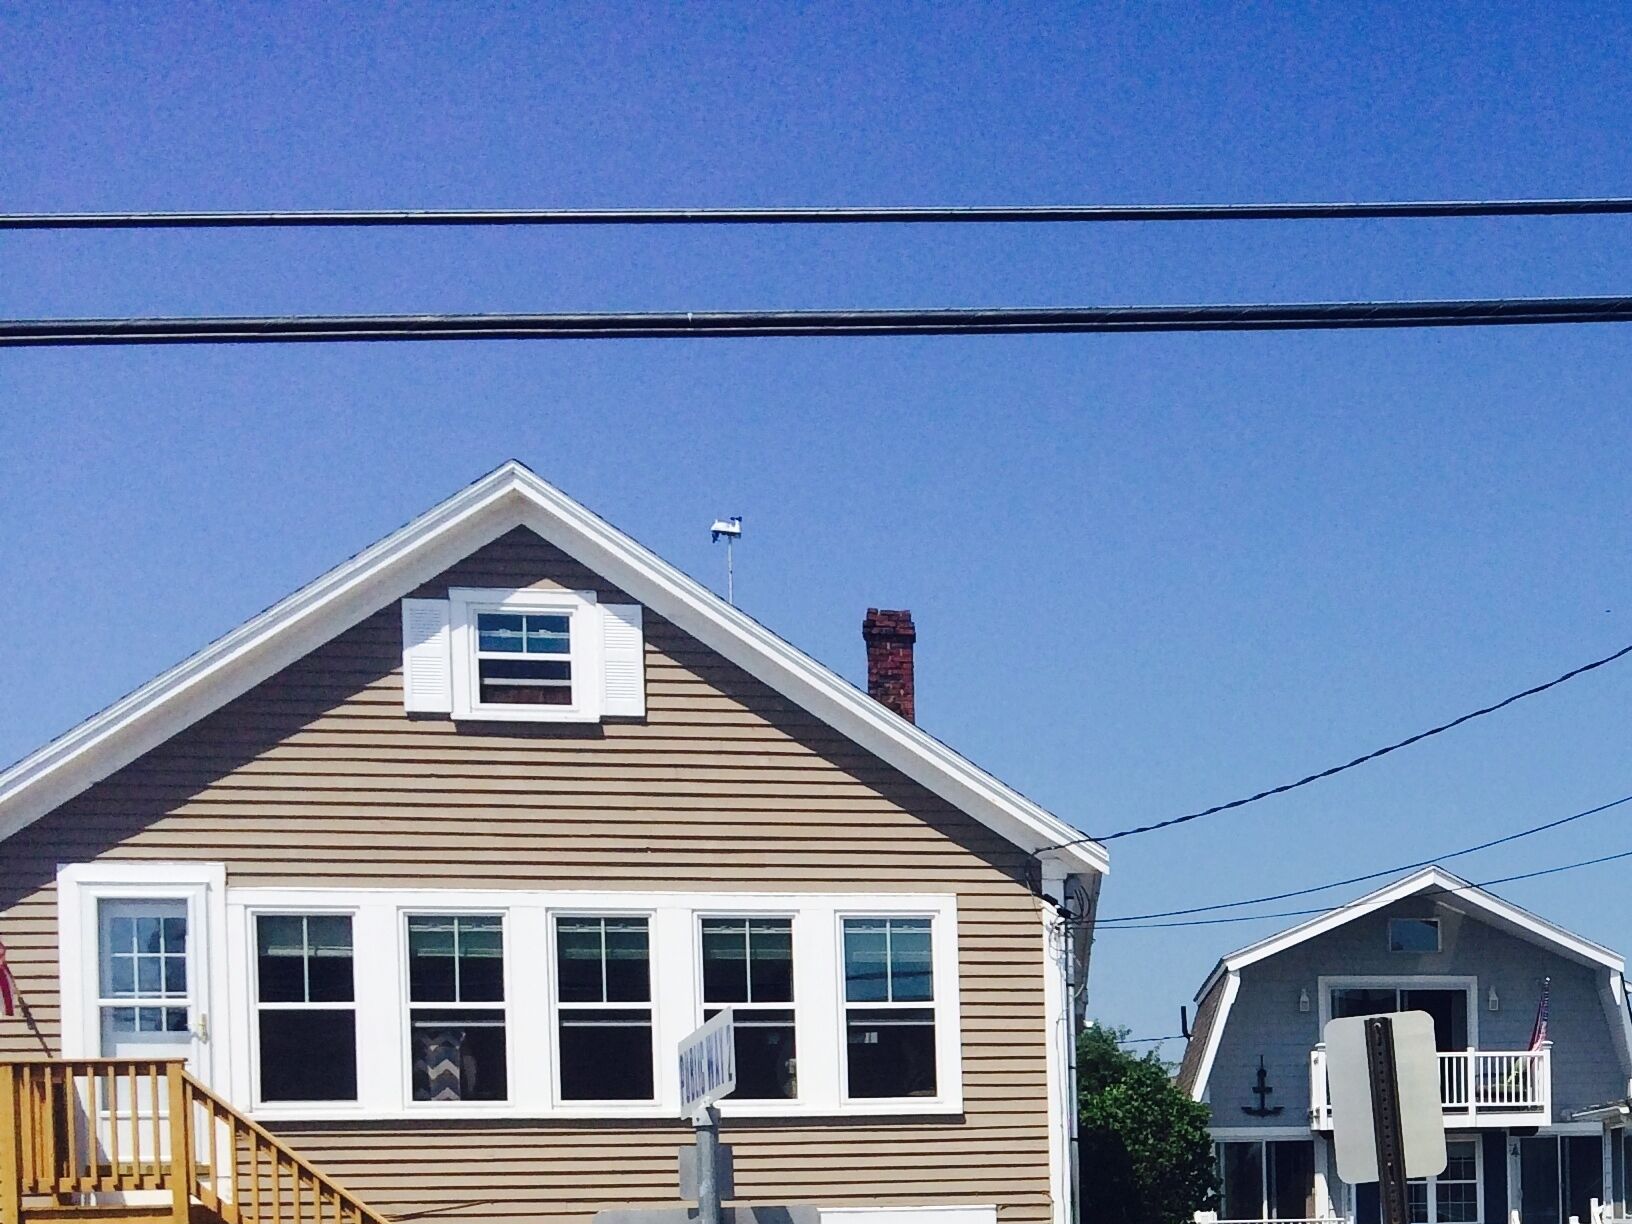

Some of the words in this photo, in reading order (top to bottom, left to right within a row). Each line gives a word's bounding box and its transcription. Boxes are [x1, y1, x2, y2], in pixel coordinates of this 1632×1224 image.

[680, 1040, 705, 1107] PUBLIC
[706, 1026, 725, 1091] WAY
[726, 1024, 733, 1082] 2
